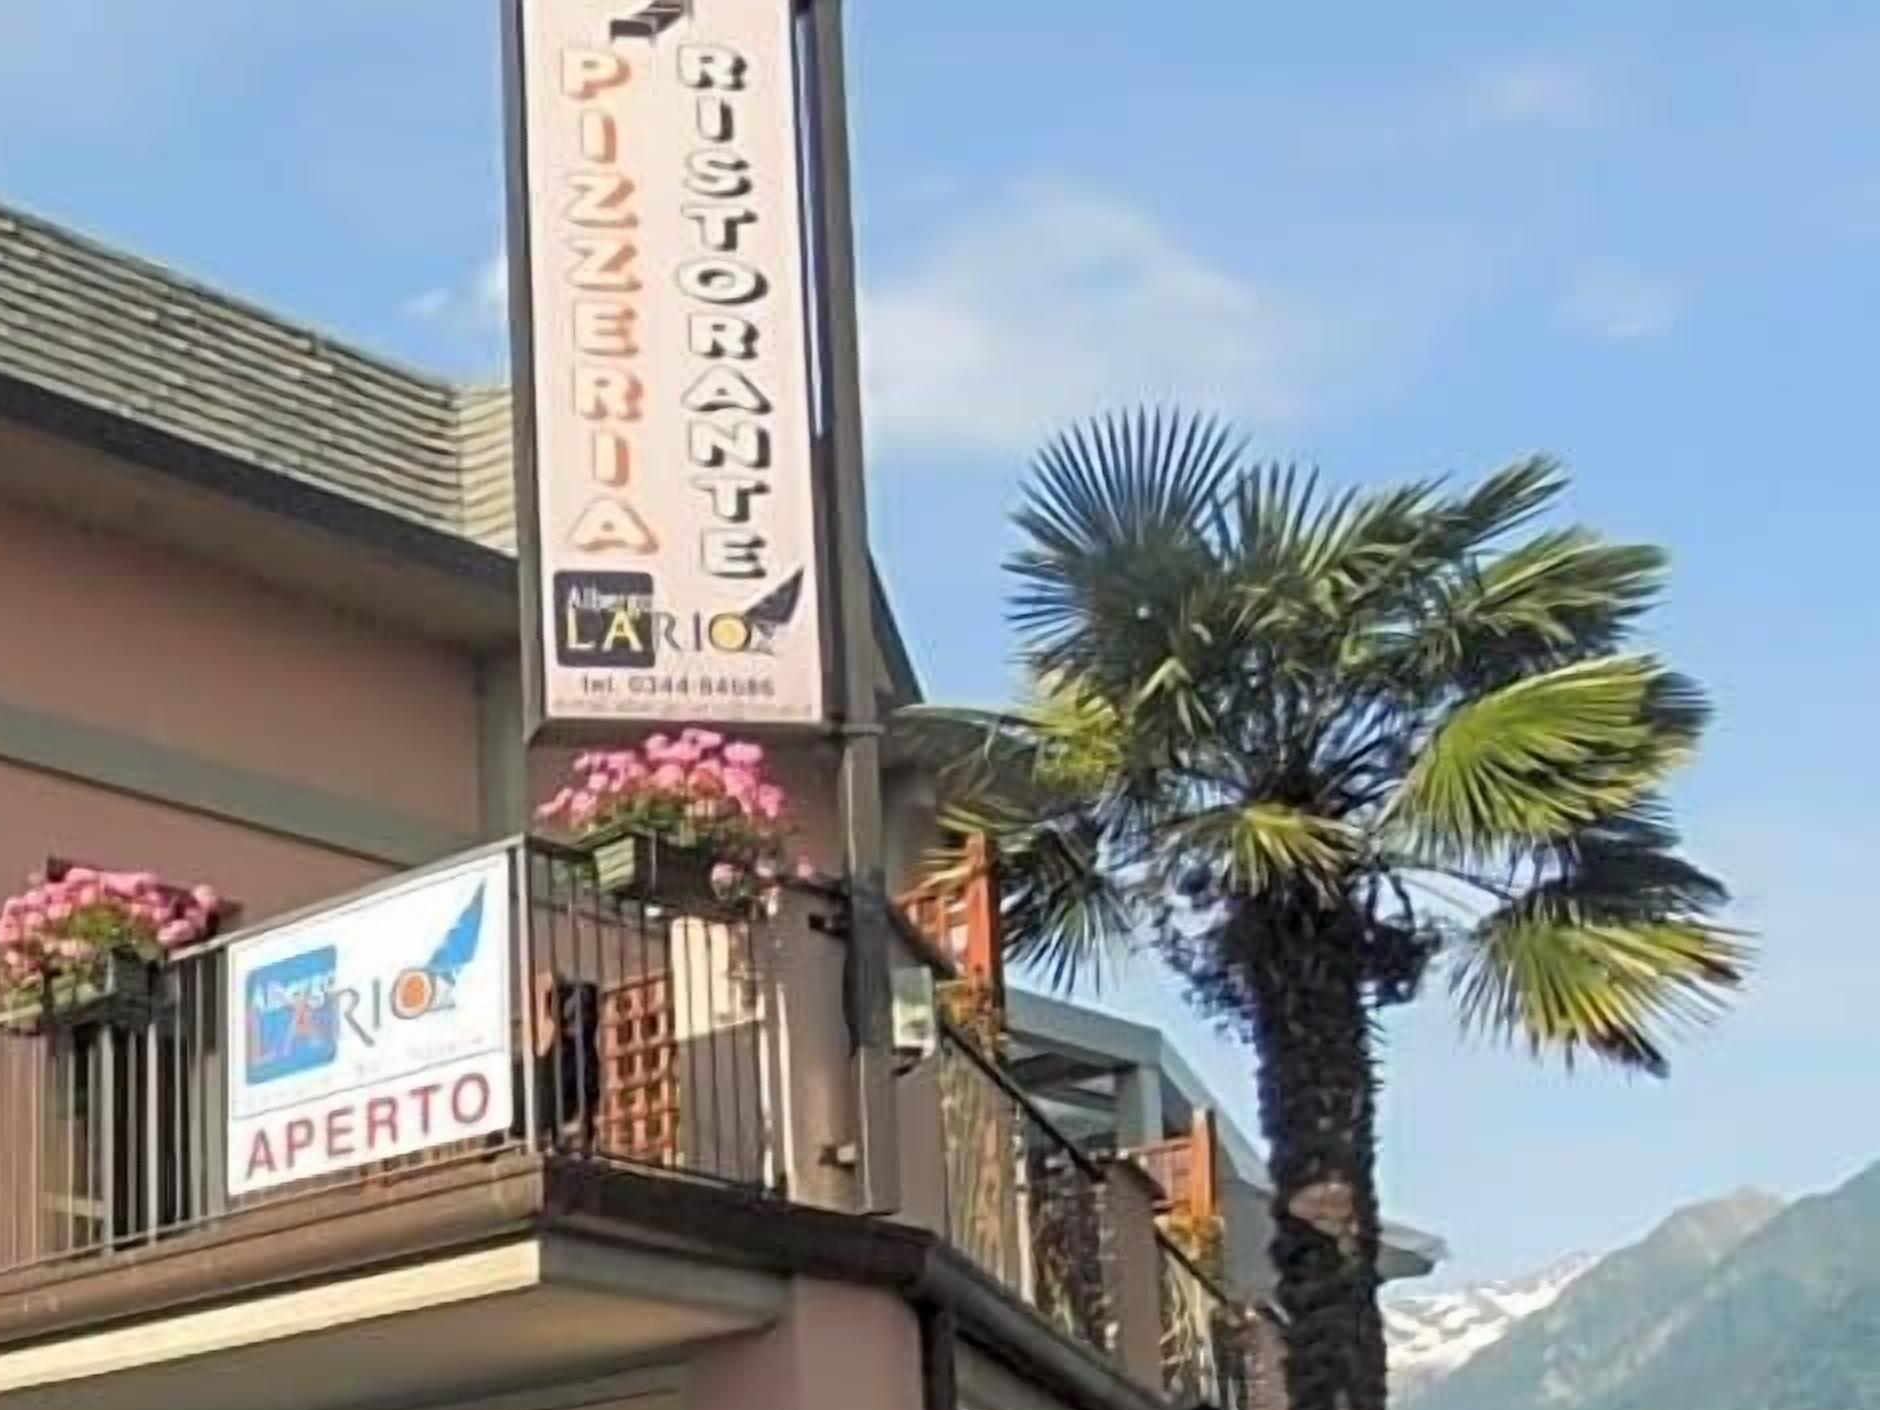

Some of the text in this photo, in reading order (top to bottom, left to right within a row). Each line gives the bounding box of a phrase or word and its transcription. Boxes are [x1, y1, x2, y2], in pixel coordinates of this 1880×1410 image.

[559, 46, 661, 554] PIZZERIA
[675, 44, 773, 579] RISTORANTE
[566, 606, 753, 656] LARIO
[244, 1072, 492, 1182] APERTO
